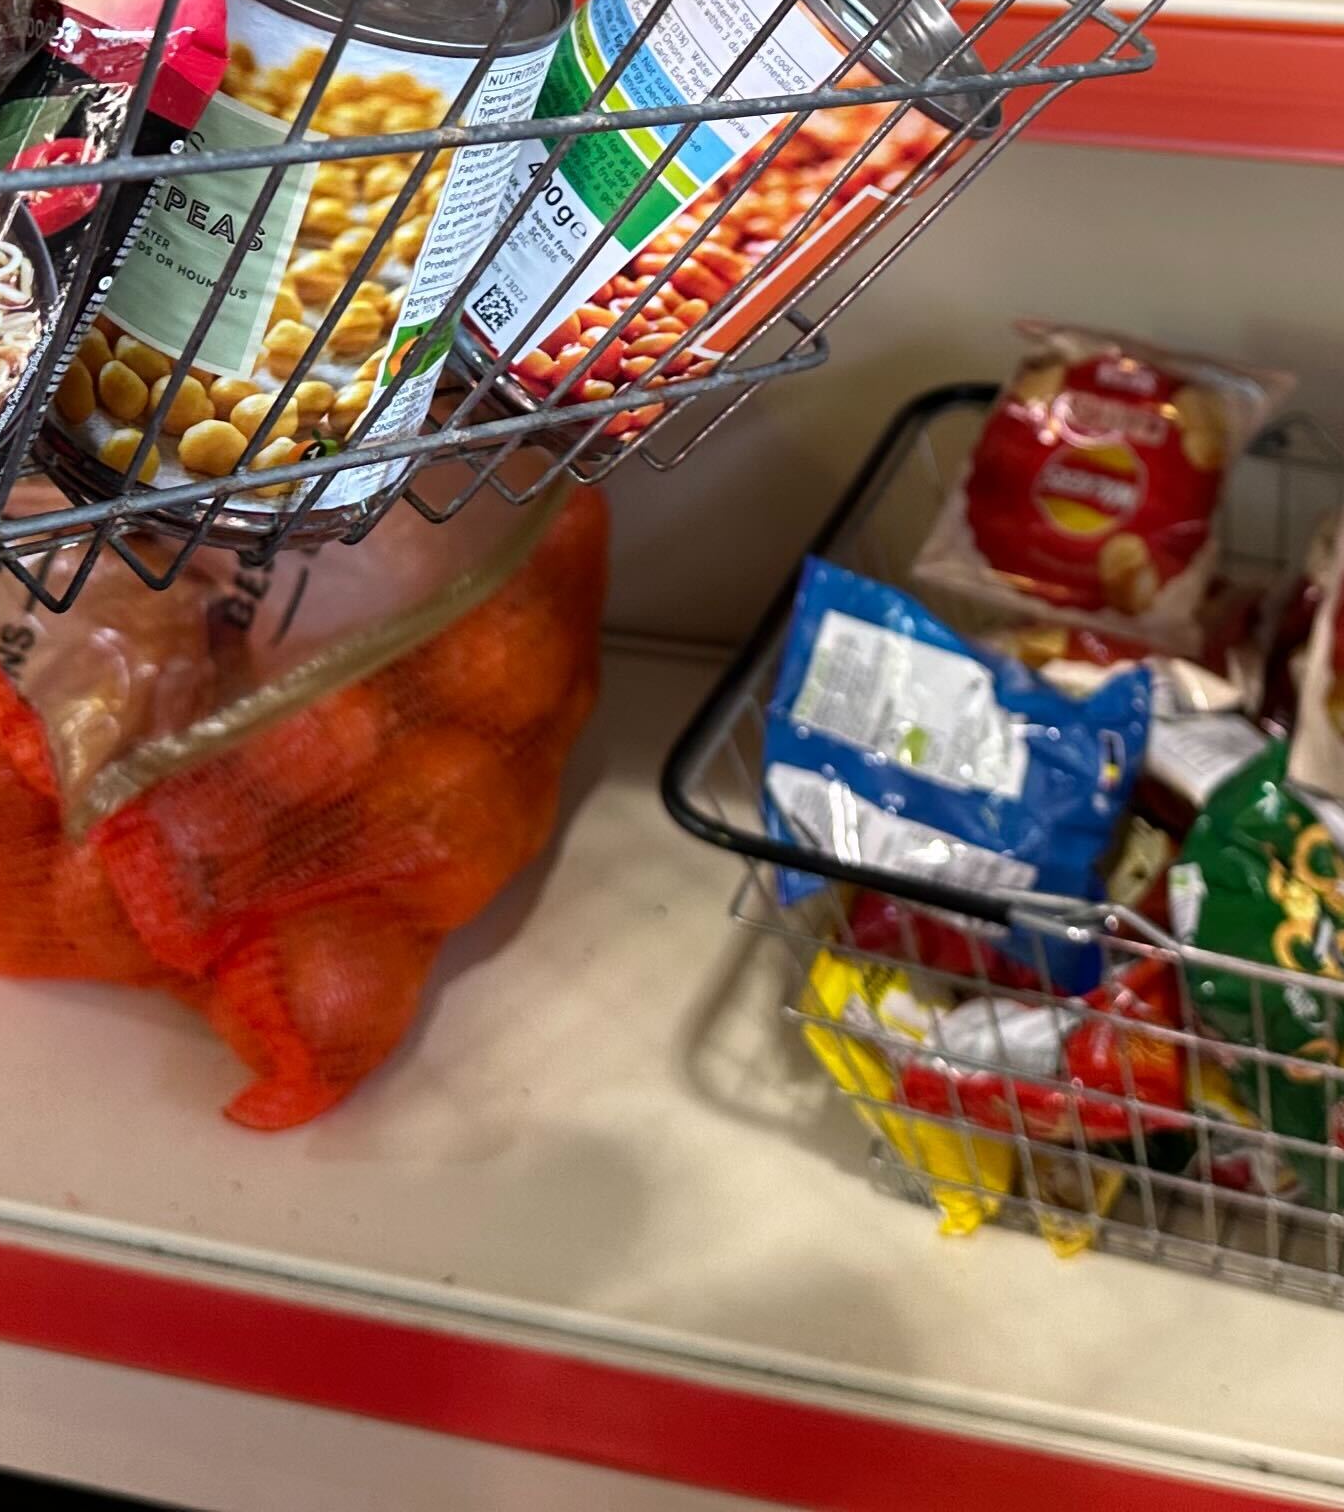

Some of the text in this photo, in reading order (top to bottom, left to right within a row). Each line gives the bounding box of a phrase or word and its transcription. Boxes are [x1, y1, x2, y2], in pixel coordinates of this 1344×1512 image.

[660, 33, 686, 64] Onions
[487, 61, 546, 88] NUTRITION
[642, 56, 656, 76] Not
[690, 50, 712, 78] Water
[461, 146, 494, 161] Energy
[142, 227, 172, 252] ATER
[531, 209, 555, 242] beans
[555, 239, 576, 265] from
[155, 253, 174, 270] OR
[177, 264, 249, 301] HOUMUS
